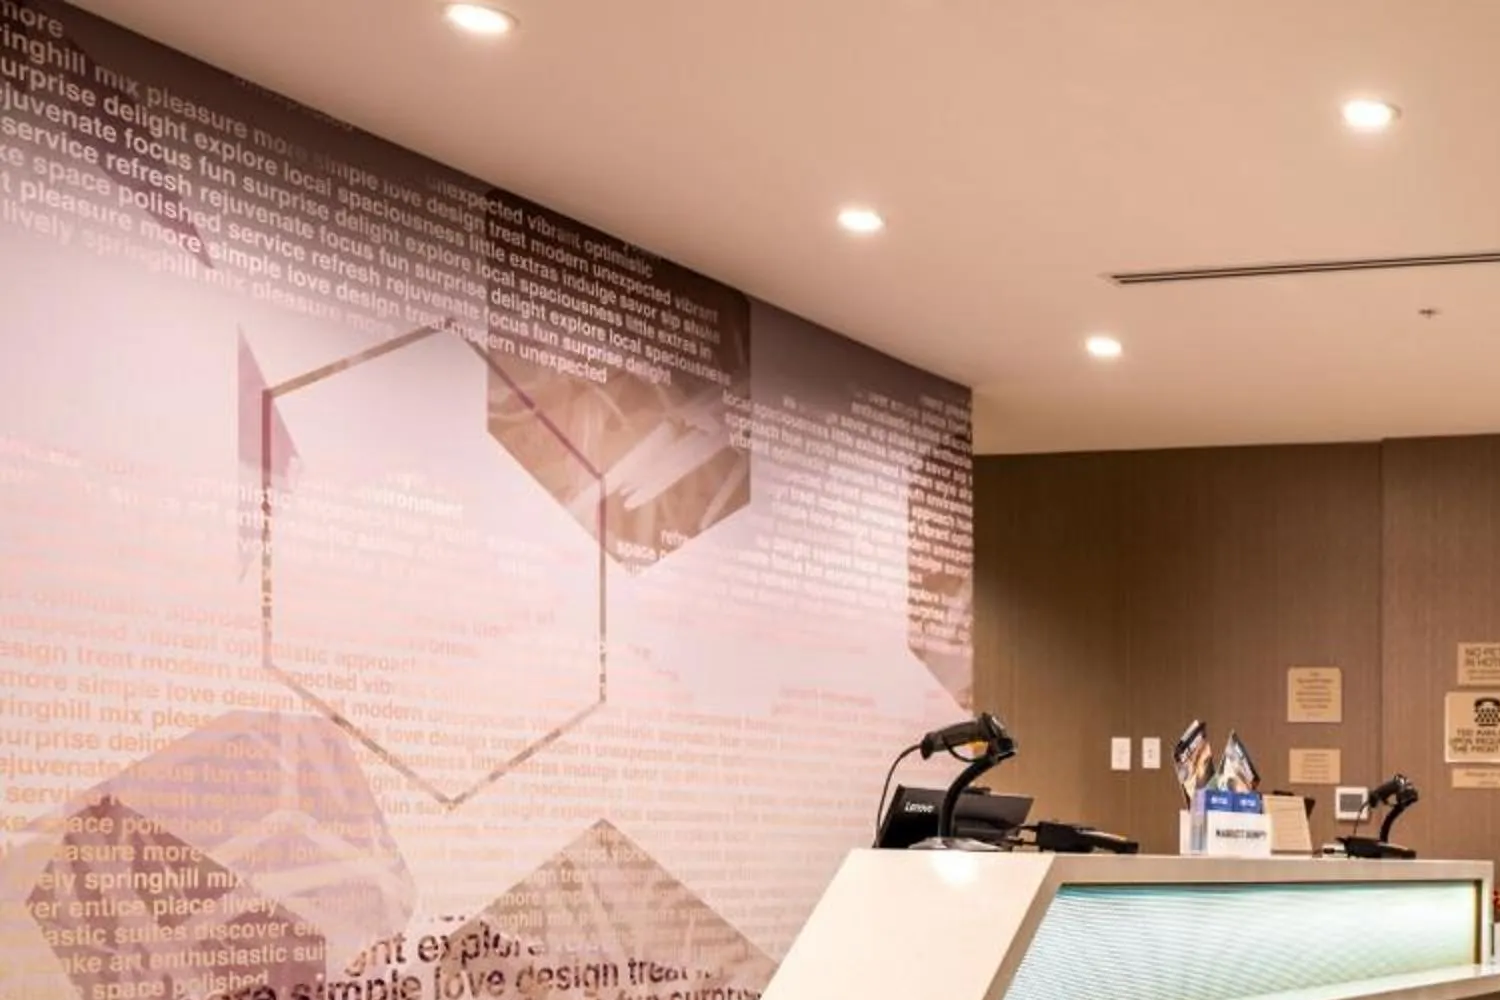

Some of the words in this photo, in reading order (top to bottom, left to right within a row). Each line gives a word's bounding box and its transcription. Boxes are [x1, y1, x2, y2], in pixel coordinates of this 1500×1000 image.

[95, 63, 139, 97] mix
[147, 84, 247, 139] pleasure
[426, 190, 484, 233] design
[489, 217, 526, 249] treat
[530, 237, 588, 273] modern
[103, 88, 187, 142] delight
[194, 129, 277, 176] explore
[283, 158, 331, 197] local
[337, 184, 465, 247] spaciousness
[469, 230, 505, 262] little
[509, 250, 558, 282] extras
[125, 124, 191, 171] focus
[199, 152, 235, 187] fun
[242, 173, 329, 221] surprise
[335, 203, 399, 247] delight
[405, 234, 470, 272] explore
[476, 256, 515, 288] local
[519, 276, 623, 328] spaciousness
[0, 113, 98, 165] service
[106, 150, 191, 197] refresh
[199, 184, 314, 240] rejuvenate
[319, 221, 373, 261] focus
[379, 243, 409, 273] fun
[414, 260, 487, 300] surprise
[491, 283, 545, 321] delight
[549, 309, 606, 342] explore
[20, 177, 132, 230] pleasure
[140, 216, 200, 252] more
[208, 238, 281, 278] simple
[288, 260, 330, 294] love
[336, 276, 399, 318] design
[519, 341, 606, 383] unexpected
[32, 153, 110, 196] space
[117, 182, 220, 233] polished
[227, 219, 305, 262] service
[312, 248, 380, 287] refresh
[386, 274, 479, 320] rejuvenate
[532, 320, 558, 346] fun
[905, 801, 935, 814] Lenovo
[67, 892, 146, 917] entice
[152, 891, 215, 921] place
[222, 890, 278, 918] lively
[83, 865, 199, 895] springhill
[114, 919, 188, 943] suites
[194, 917, 282, 940] discover
[108, 948, 142, 971] art
[149, 941, 282, 969] enthusiastic
[433, 965, 505, 1000] love
[514, 957, 619, 998] design
